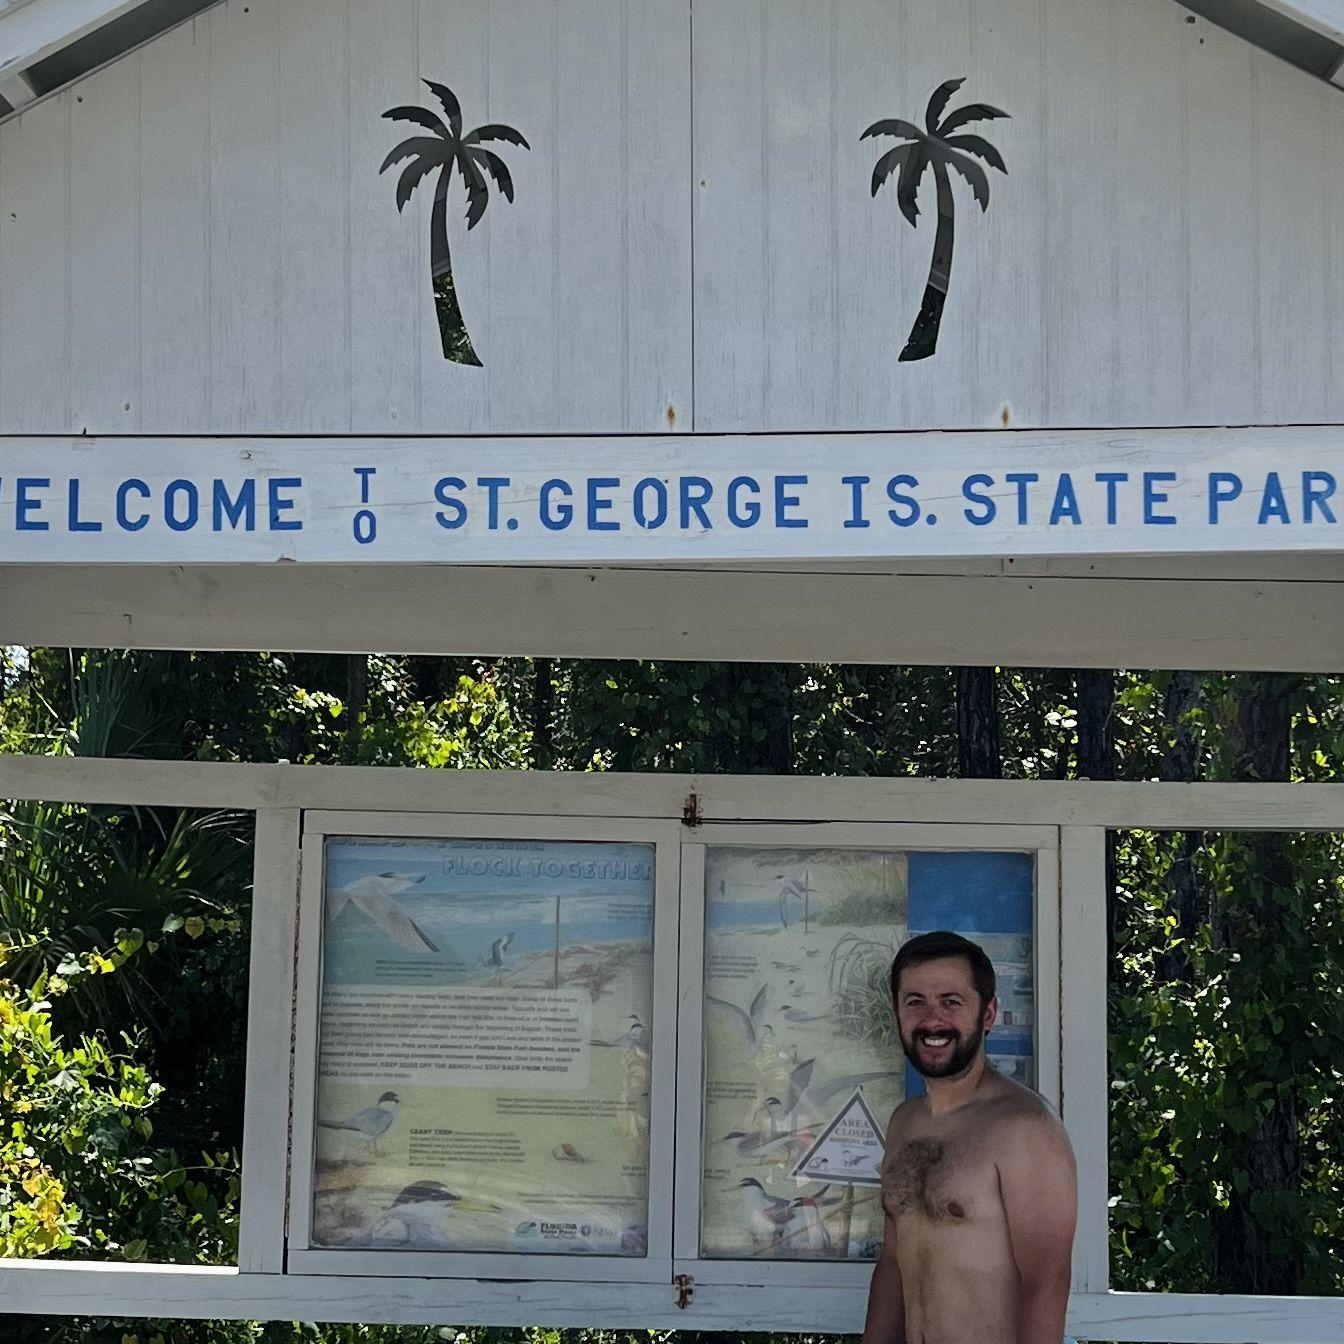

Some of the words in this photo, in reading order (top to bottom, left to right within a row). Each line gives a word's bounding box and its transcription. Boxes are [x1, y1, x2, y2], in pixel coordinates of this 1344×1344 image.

[352, 467, 378, 545] TO
[842, 474, 938, 529] IS.
[962, 472, 1177, 527] STATE
[442, 855, 521, 876] FLOCK
